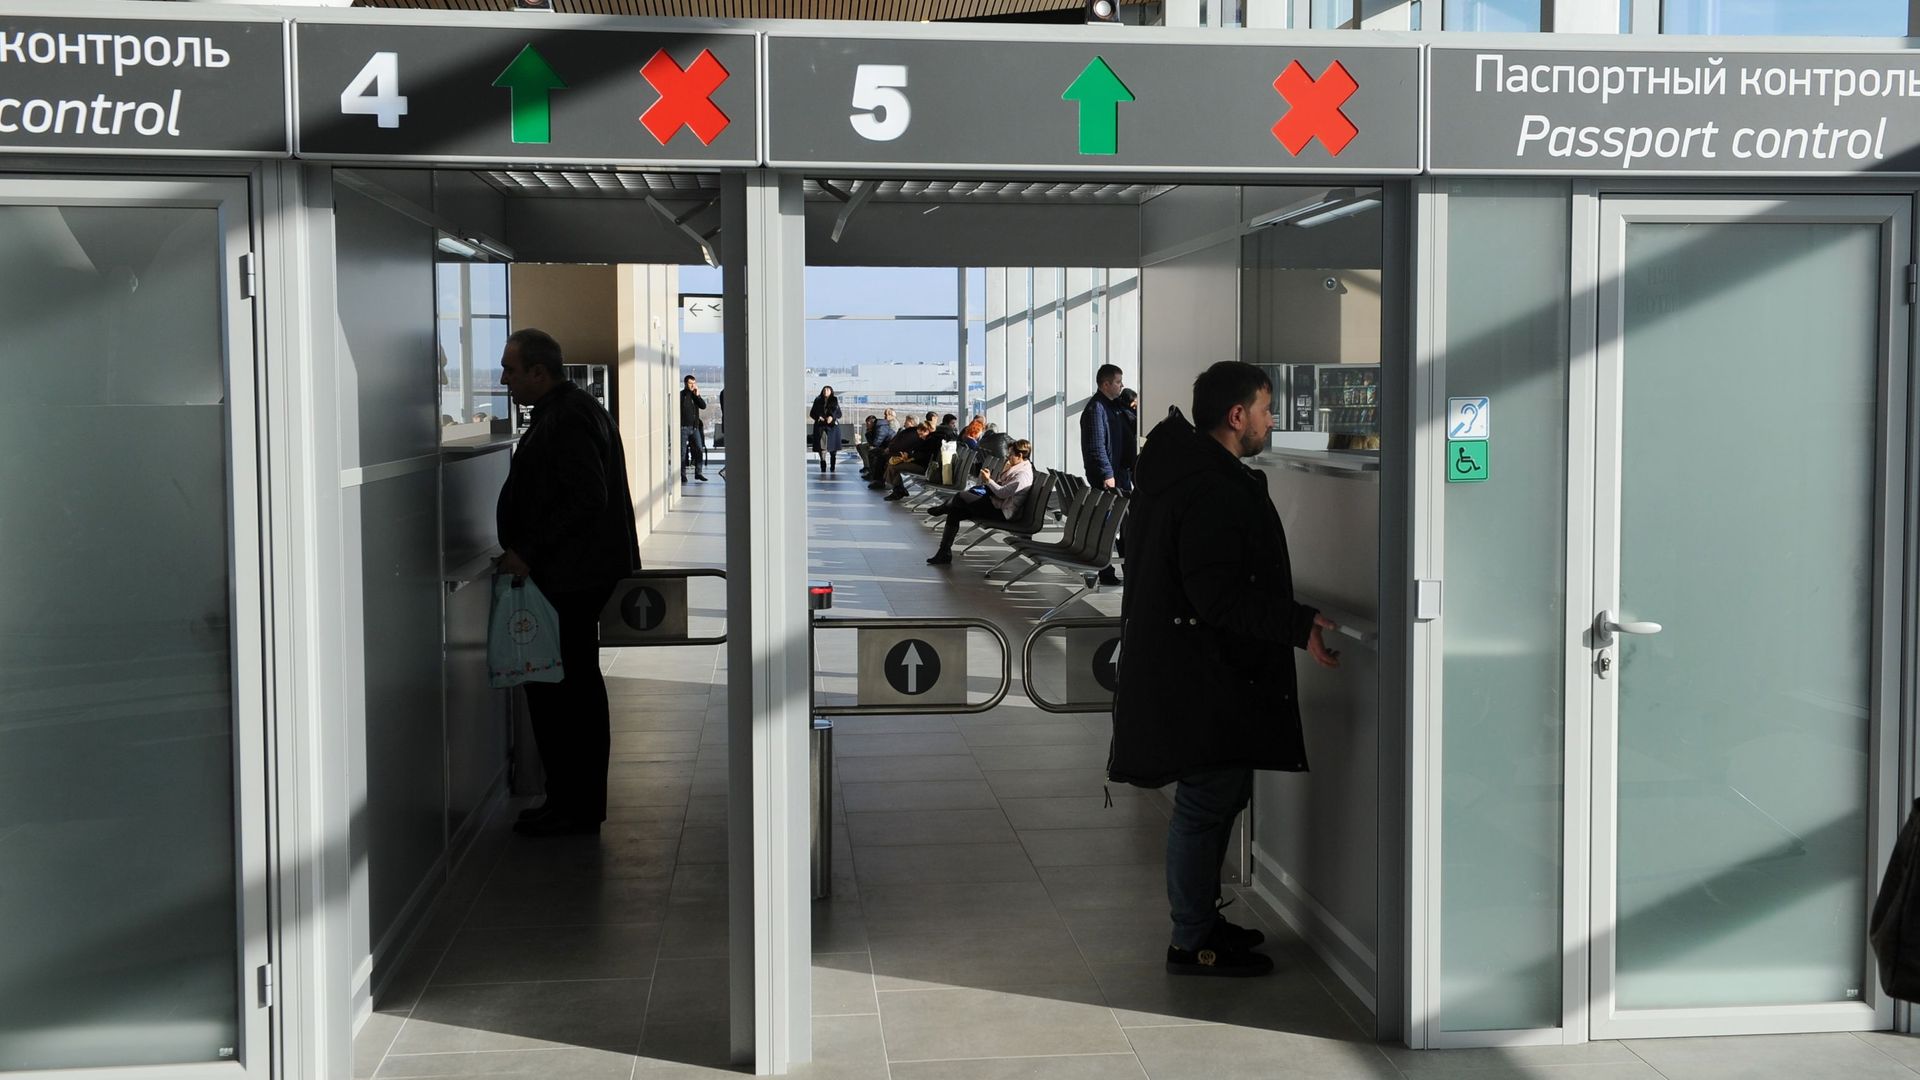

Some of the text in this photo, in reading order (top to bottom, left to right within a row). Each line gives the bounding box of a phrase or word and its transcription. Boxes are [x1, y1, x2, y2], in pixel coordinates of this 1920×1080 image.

[0, 31, 231, 76] контроль
[1475, 54, 1727, 104] Паспортный
[0, 89, 182, 137] control
[340, 51, 408, 129] 4
[849, 64, 911, 142] 5
[1516, 114, 1888, 169] Passport control
